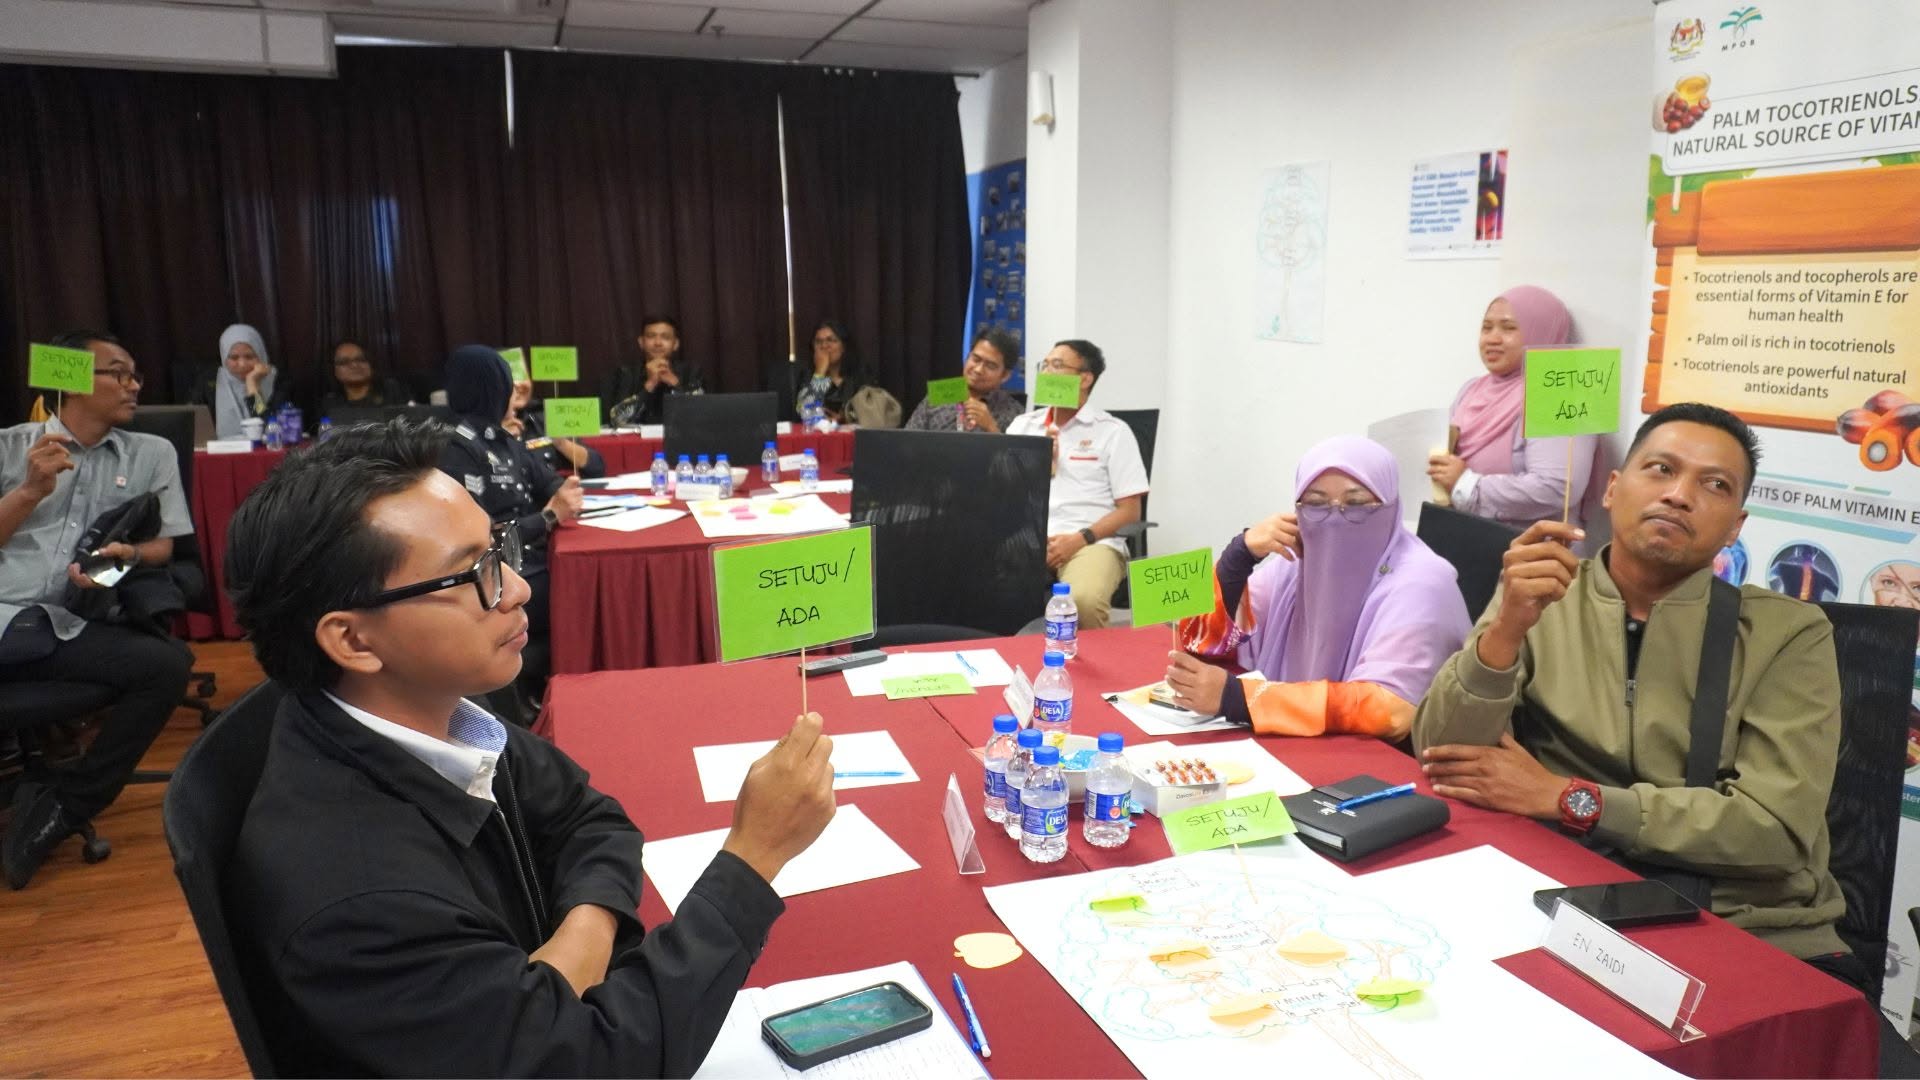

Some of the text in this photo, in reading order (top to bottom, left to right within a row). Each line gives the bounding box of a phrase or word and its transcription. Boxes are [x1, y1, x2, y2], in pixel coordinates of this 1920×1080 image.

[1721, 39, 1755, 51] MPOB
[1713, 108, 1761, 130] PALM
[1673, 136, 1748, 157] NATURAL
[1754, 124, 1831, 148] SOURCE
[1838, 118, 1865, 139] OF
[1694, 268, 1919, 286] Tocotrienols and tocopherols are
[1696, 289, 1909, 304] essential forms of Vitamin E for
[1748, 308, 1844, 323] human health
[1697, 333, 1896, 354] Palm oil is rich in tocotrienols
[1543, 361, 1615, 394] SETUJU/
[1682, 358, 1907, 384] Tocotrienols are powerful natural
[1744, 380, 1829, 398] antioxidants
[1556, 400, 1588, 420] ADA
[1750, 485, 1780, 501] FITS
[1783, 490, 1800, 504] OF
[1804, 493, 1841, 512] PALM
[1845, 500, 1907, 523] VITAMIN
[758, 547, 856, 588] SETUJU/
[1144, 555, 1207, 584] SETUJU/
[1162, 589, 1190, 605] ADA
[776, 606, 820, 627] ADA
[1186, 797, 1271, 827] SETUJU/
[1212, 824, 1248, 839] ADA
[1572, 932, 1593, 953] EN
